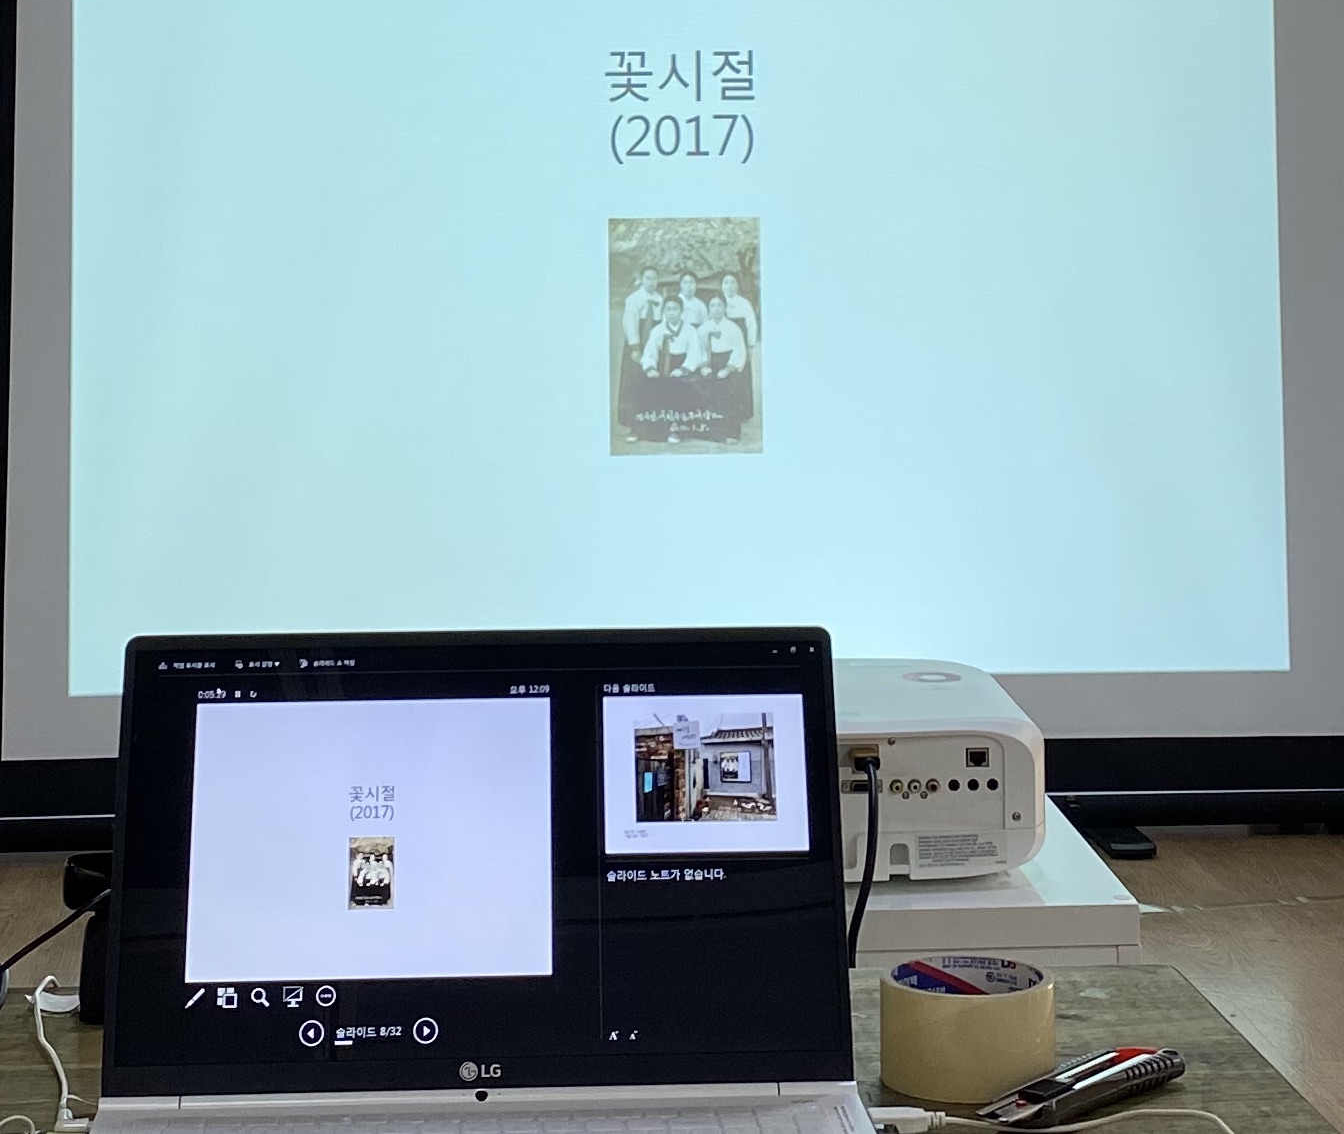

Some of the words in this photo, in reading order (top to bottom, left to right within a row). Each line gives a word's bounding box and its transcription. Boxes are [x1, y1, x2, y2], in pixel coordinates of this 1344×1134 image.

[604, 48, 757, 103] 꽃시절
[609, 114, 756, 164] (2017)
[509, 685, 526, 695] 오후
[528, 684, 550, 694] 12:09
[603, 684, 620, 693] 다음
[622, 683, 655, 693] 슬라이드
[348, 785, 395, 803] 꽃시절
[349, 805, 394, 822] (2017)
[606, 869, 648, 882] 슬라이드
[649, 869, 681, 881] 노트가
[683, 868, 727, 881] 없습니다.
[335, 1026, 377, 1039] 슬라이드
[379, 1026, 402, 1037] 8/32
[480, 1064, 502, 1078] LG
